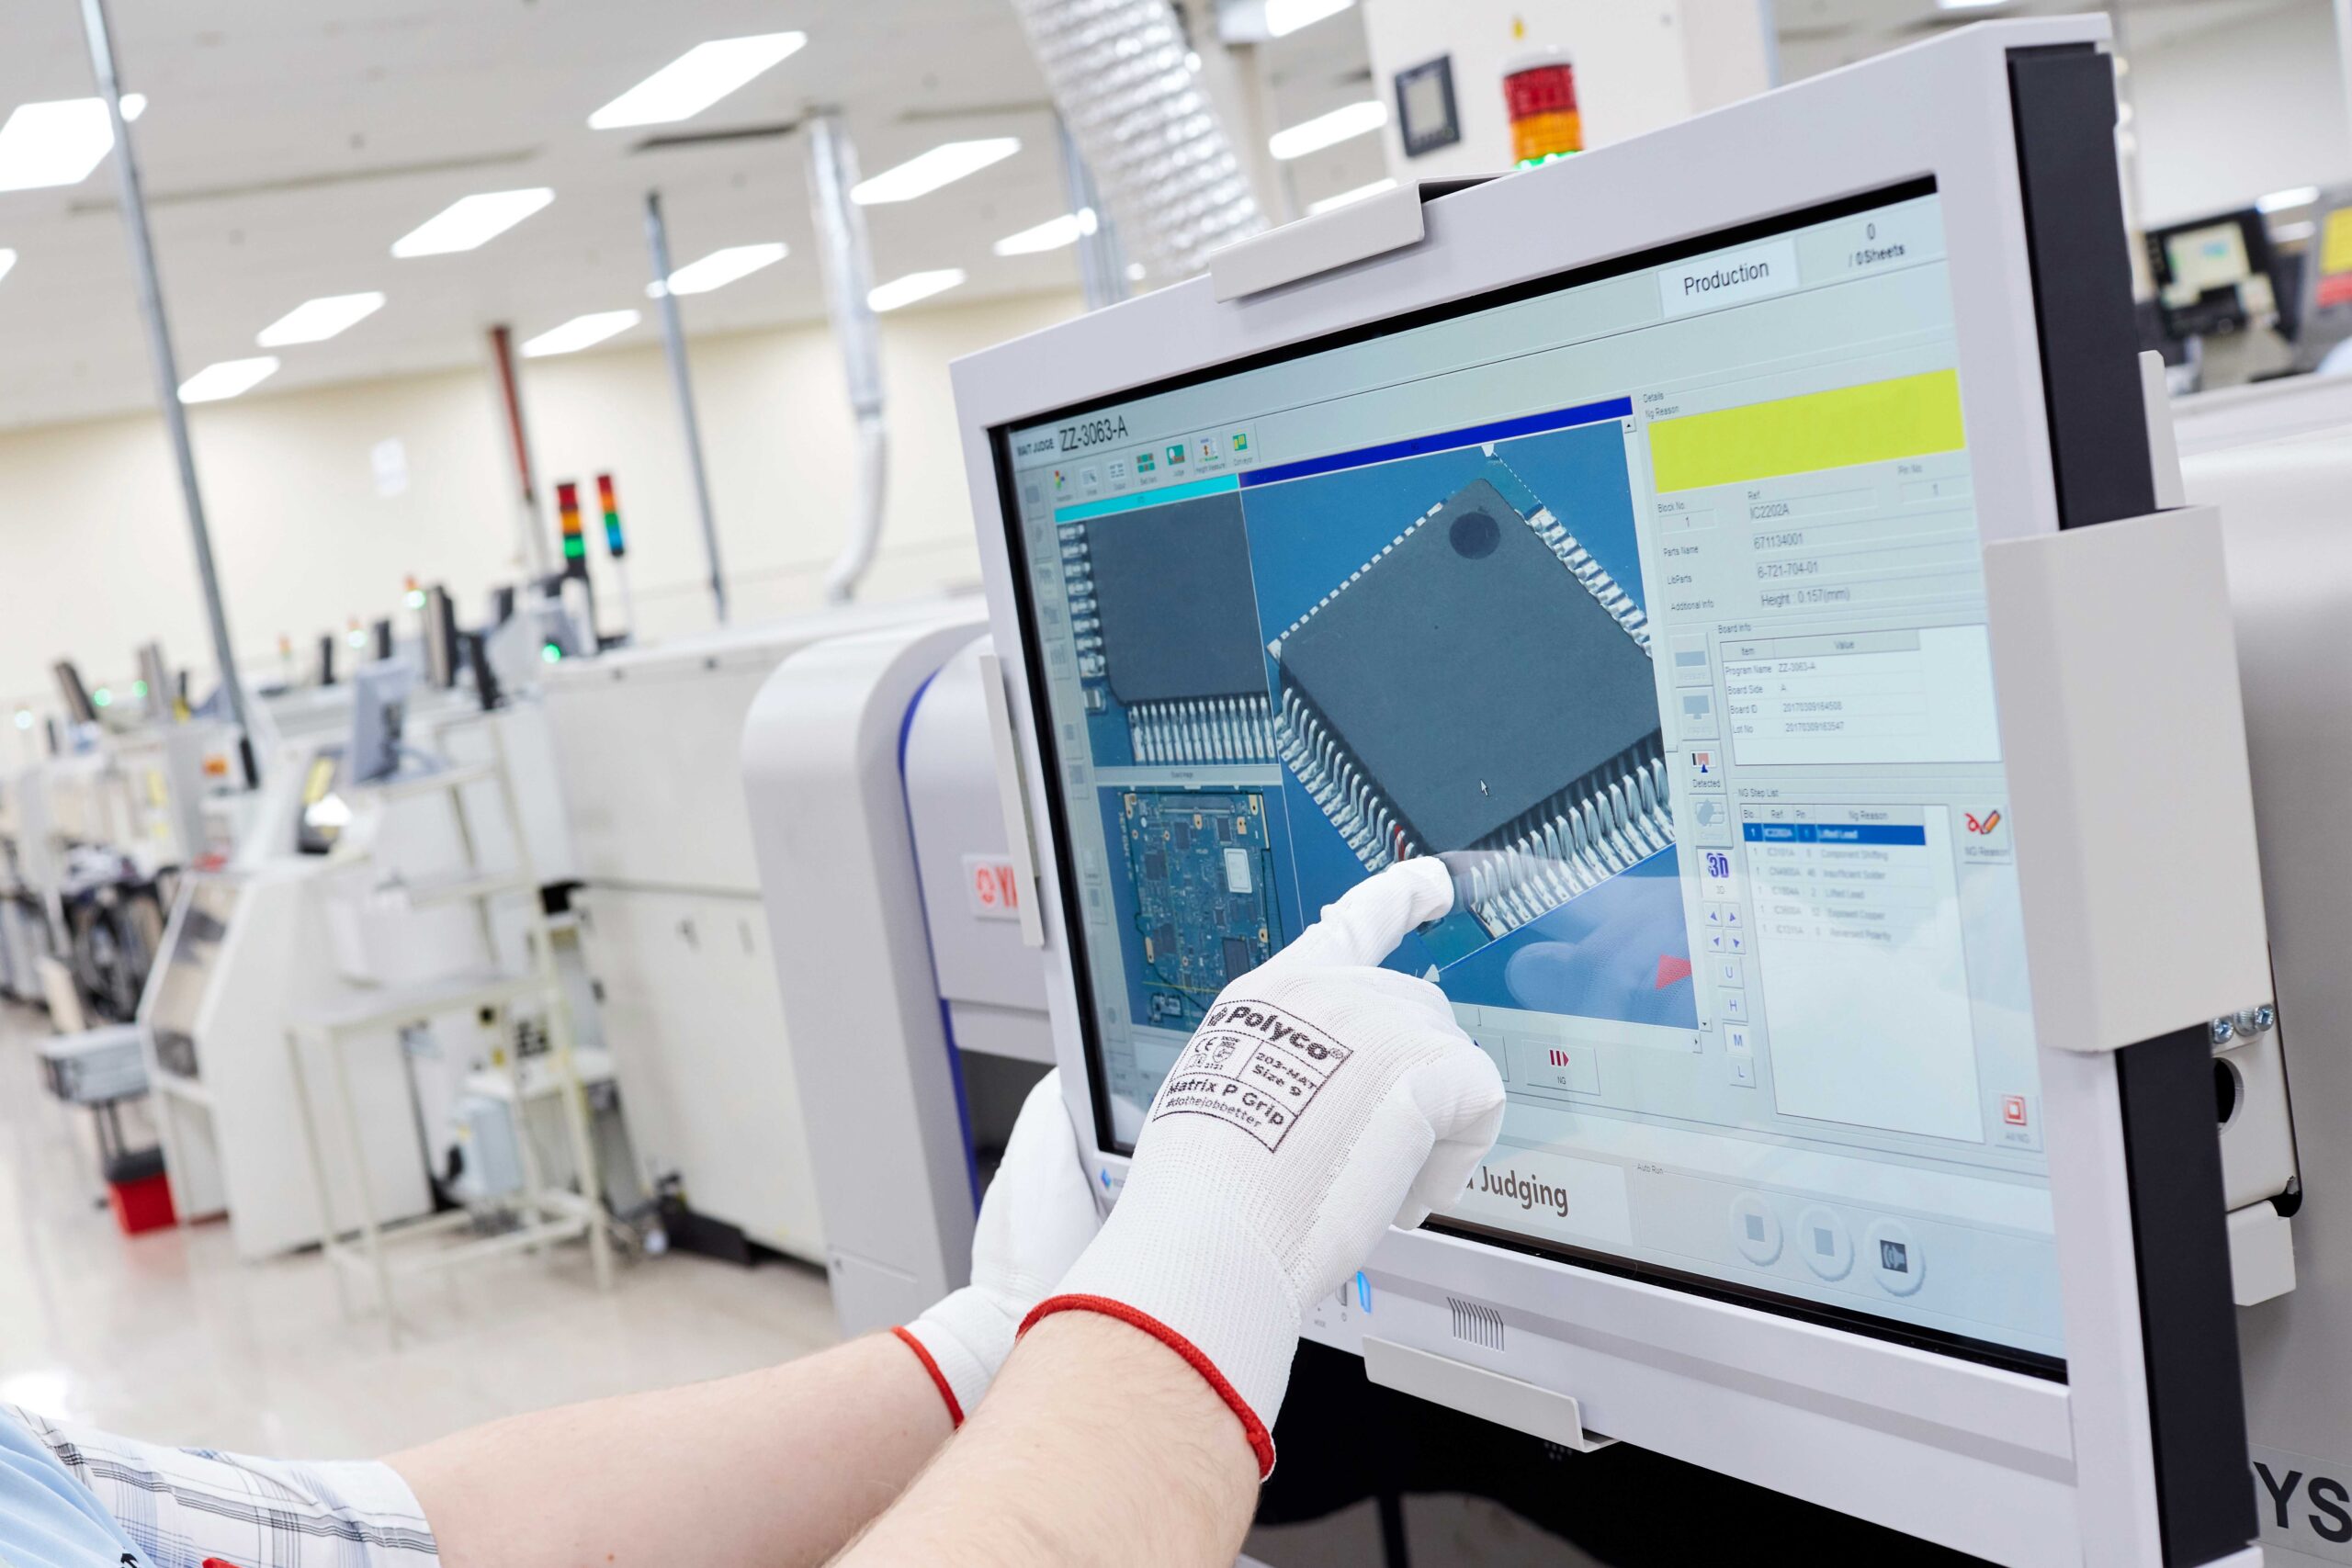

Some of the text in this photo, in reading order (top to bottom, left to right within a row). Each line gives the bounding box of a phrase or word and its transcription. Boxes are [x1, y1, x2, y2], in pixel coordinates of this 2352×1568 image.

[1866, 222, 1876, 240] 0
[1683, 260, 1770, 296] Production
[1643, 390, 1665, 403] Details
[1656, 403, 1680, 415] Reason
[1059, 414, 1129, 452] ZZ-3063-A
[1033, 437, 1055, 453] JUDGE
[1657, 502, 1674, 513] Block
[1754, 532, 1804, 549] 671134001
[1663, 545, 1699, 557] Parts Name
[1757, 561, 1819, 580] 6-721-704-01
[1760, 592, 1791, 611] Height
[1797, 588, 1850, 604] 0.157(mm)
[1717, 624, 1736, 635] Board
[1724, 664, 1772, 677] Program Name
[1727, 683, 1764, 695] Board Side
[1729, 704, 1749, 715] Board
[1692, 778, 1721, 789] Detected
[1749, 788, 1766, 799] Step
[1767, 787, 1780, 797] List
[1724, 965, 1734, 979] U
[1729, 999, 1737, 1011] H
[1734, 1033, 1743, 1047] M
[1255, 1053, 1319, 1090] 203-MAT
[1737, 1065, 1746, 1078] L
[1251, 1064, 1303, 1098] Size 9
[1557, 1076, 1566, 1085] NG
[1166, 1078, 1284, 1127] Matrix P Grip
[1636, 1162, 1664, 1175] Auto Run
[1480, 1165, 1569, 1218] Judging
[2252, 1461, 2352, 1544] YS
